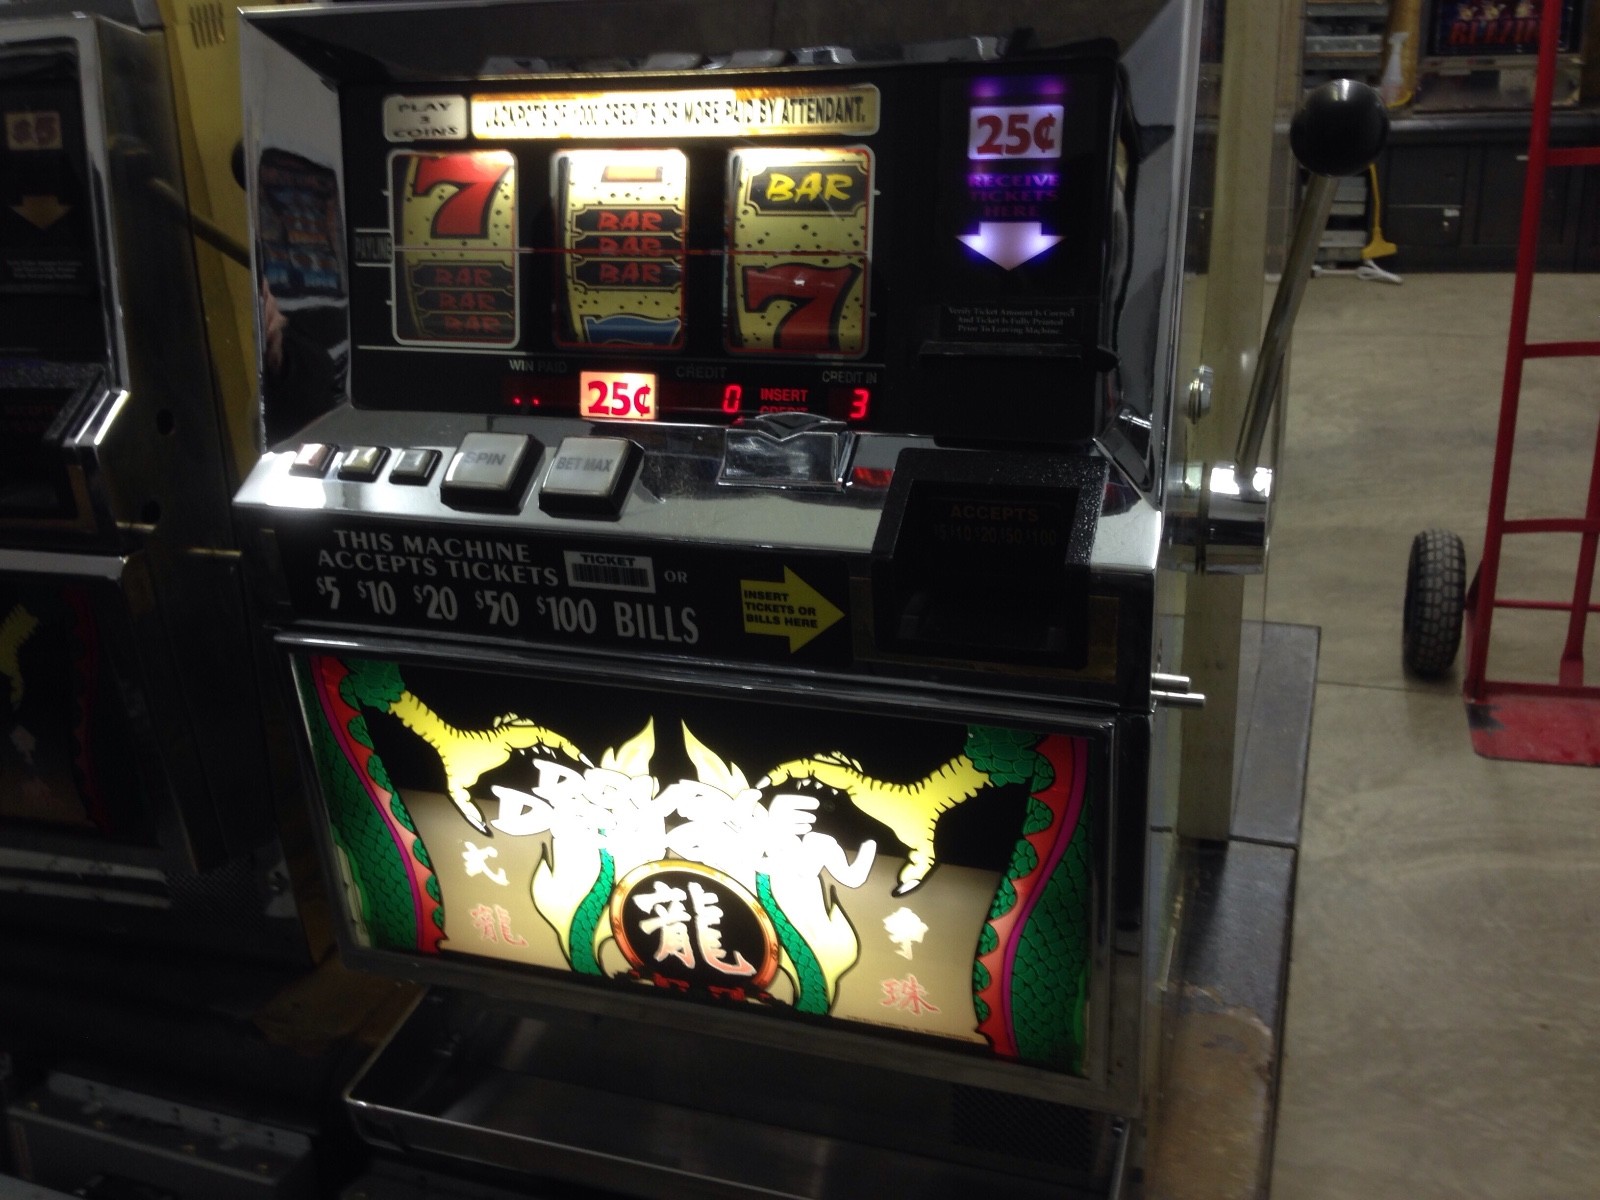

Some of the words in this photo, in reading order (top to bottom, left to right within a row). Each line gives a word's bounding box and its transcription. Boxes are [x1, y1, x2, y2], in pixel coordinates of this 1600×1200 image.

[398, 102, 452, 113] PLAY
[759, 98, 775, 124] BY
[781, 95, 867, 125] ATTENDANT.
[392, 127, 459, 138] COINS
[976, 112, 1057, 156] 25¢
[765, 171, 854, 204] BAR
[967, 173, 1061, 188] RECEIVE
[969, 189, 1060, 202] TICKETS
[982, 204, 1041, 217] HERE
[597, 210, 664, 232] BAR
[597, 236, 663, 257] BAR
[434, 266, 494, 288] BAR
[598, 262, 663, 284] BAR
[438, 290, 498, 312] BAR
[443, 314, 502, 335] BAR
[509, 359, 534, 372] WIN
[537, 360, 568, 374] PAID
[676, 365, 728, 379] CREDIT
[822, 370, 863, 384] CREDIT
[865, 372, 878, 385] IN
[587, 380, 652, 417] 25¢
[722, 383, 743, 414] 0
[759, 387, 808, 402] INSERT
[849, 386, 869, 418] 3
[464, 450, 507, 467] SPIN
[556, 456, 583, 470] BET
[583, 457, 614, 472] MAX
[950, 504, 1040, 522] ACCEPTS
[333, 529, 394, 554] THIS
[402, 535, 532, 563] MACHINE
[317, 549, 438, 577] ACCEPTS
[444, 559, 559, 587] TICKETS
[580, 552, 636, 567] TICKET
[664, 568, 689, 584] OR
[743, 589, 789, 602] INSERT
[316, 575, 342, 611] $5
[357, 578, 397, 617] $10
[413, 584, 459, 622] $20
[474, 589, 519, 627] $50
[536, 595, 597, 634] $100
[613, 601, 700, 645] BILLS
[744, 601, 795, 615] TICKETS
[798, 605, 817, 617] OR
[745, 613, 781, 625] BILLS
[784, 616, 818, 629] HERE
